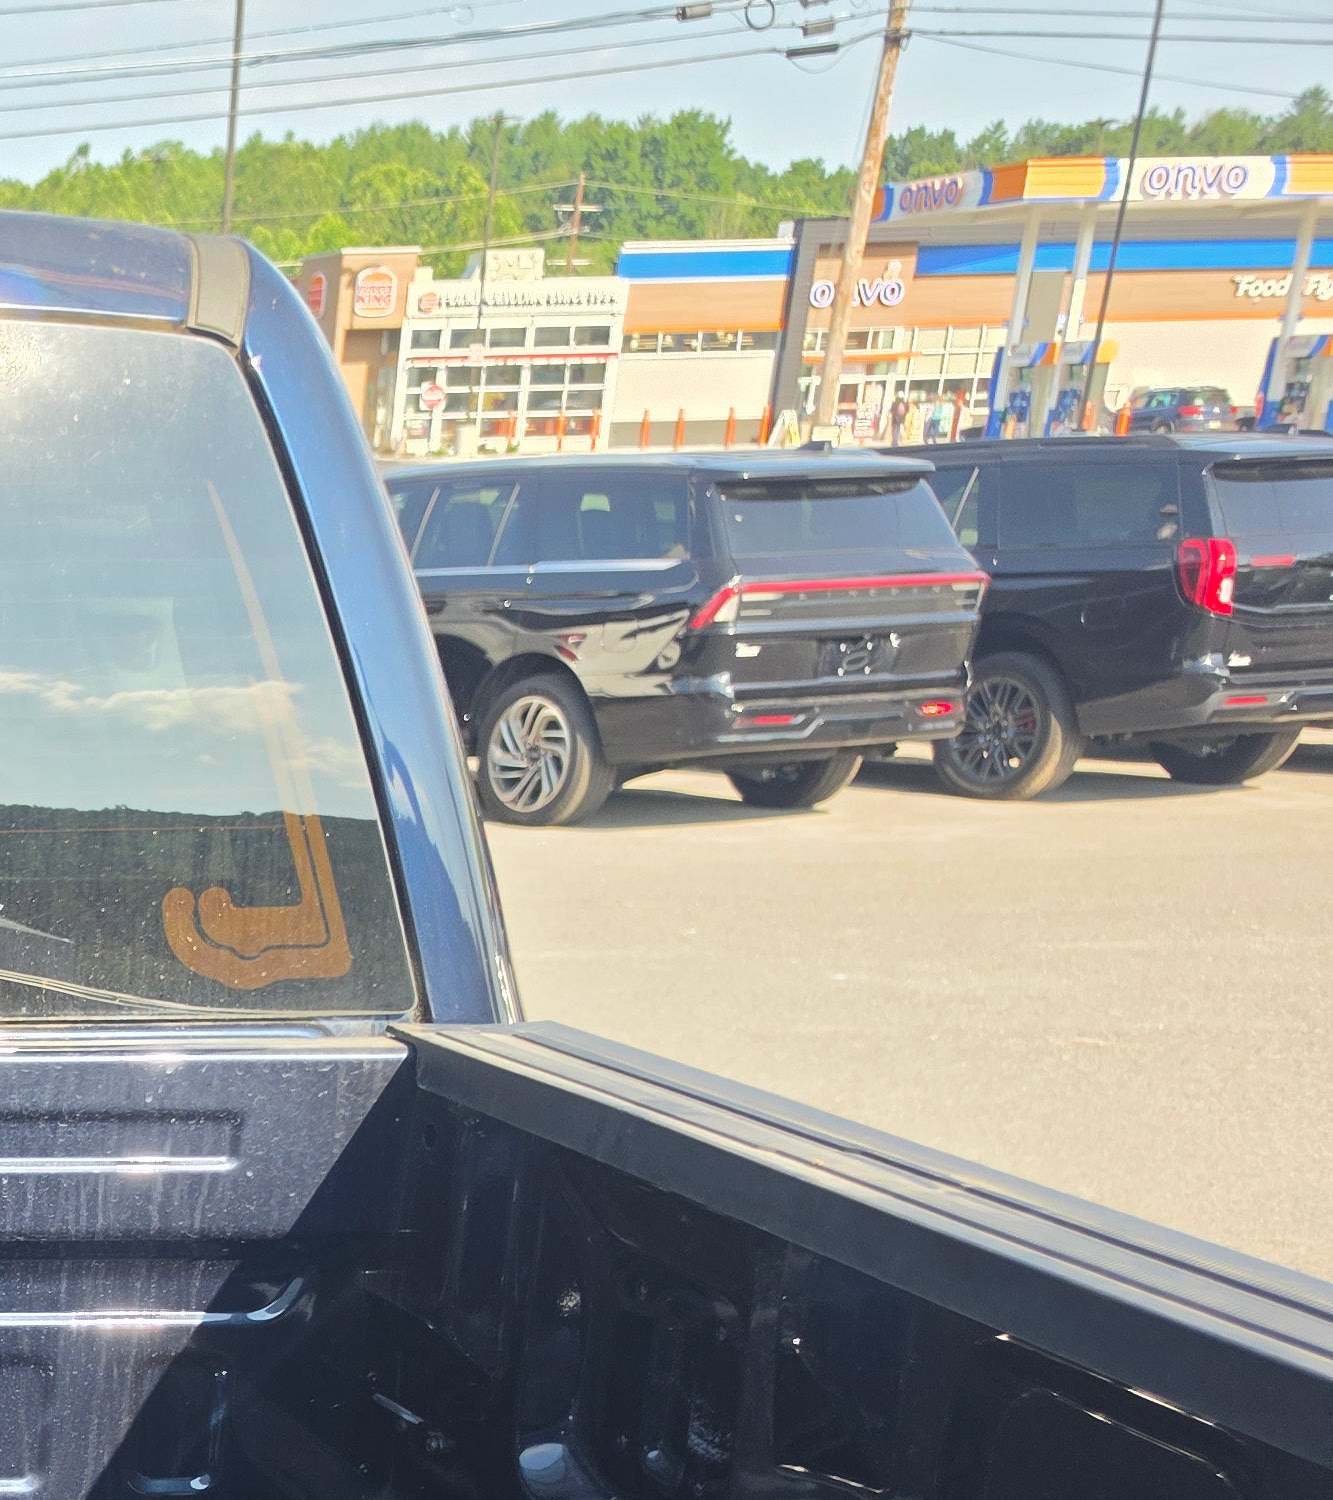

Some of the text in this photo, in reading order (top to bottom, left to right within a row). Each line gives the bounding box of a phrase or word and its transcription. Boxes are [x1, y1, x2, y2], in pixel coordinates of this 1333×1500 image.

[1145, 163, 1249, 196] onvo
[810, 279, 905, 308] ovo
[1231, 273, 1293, 297] Food
